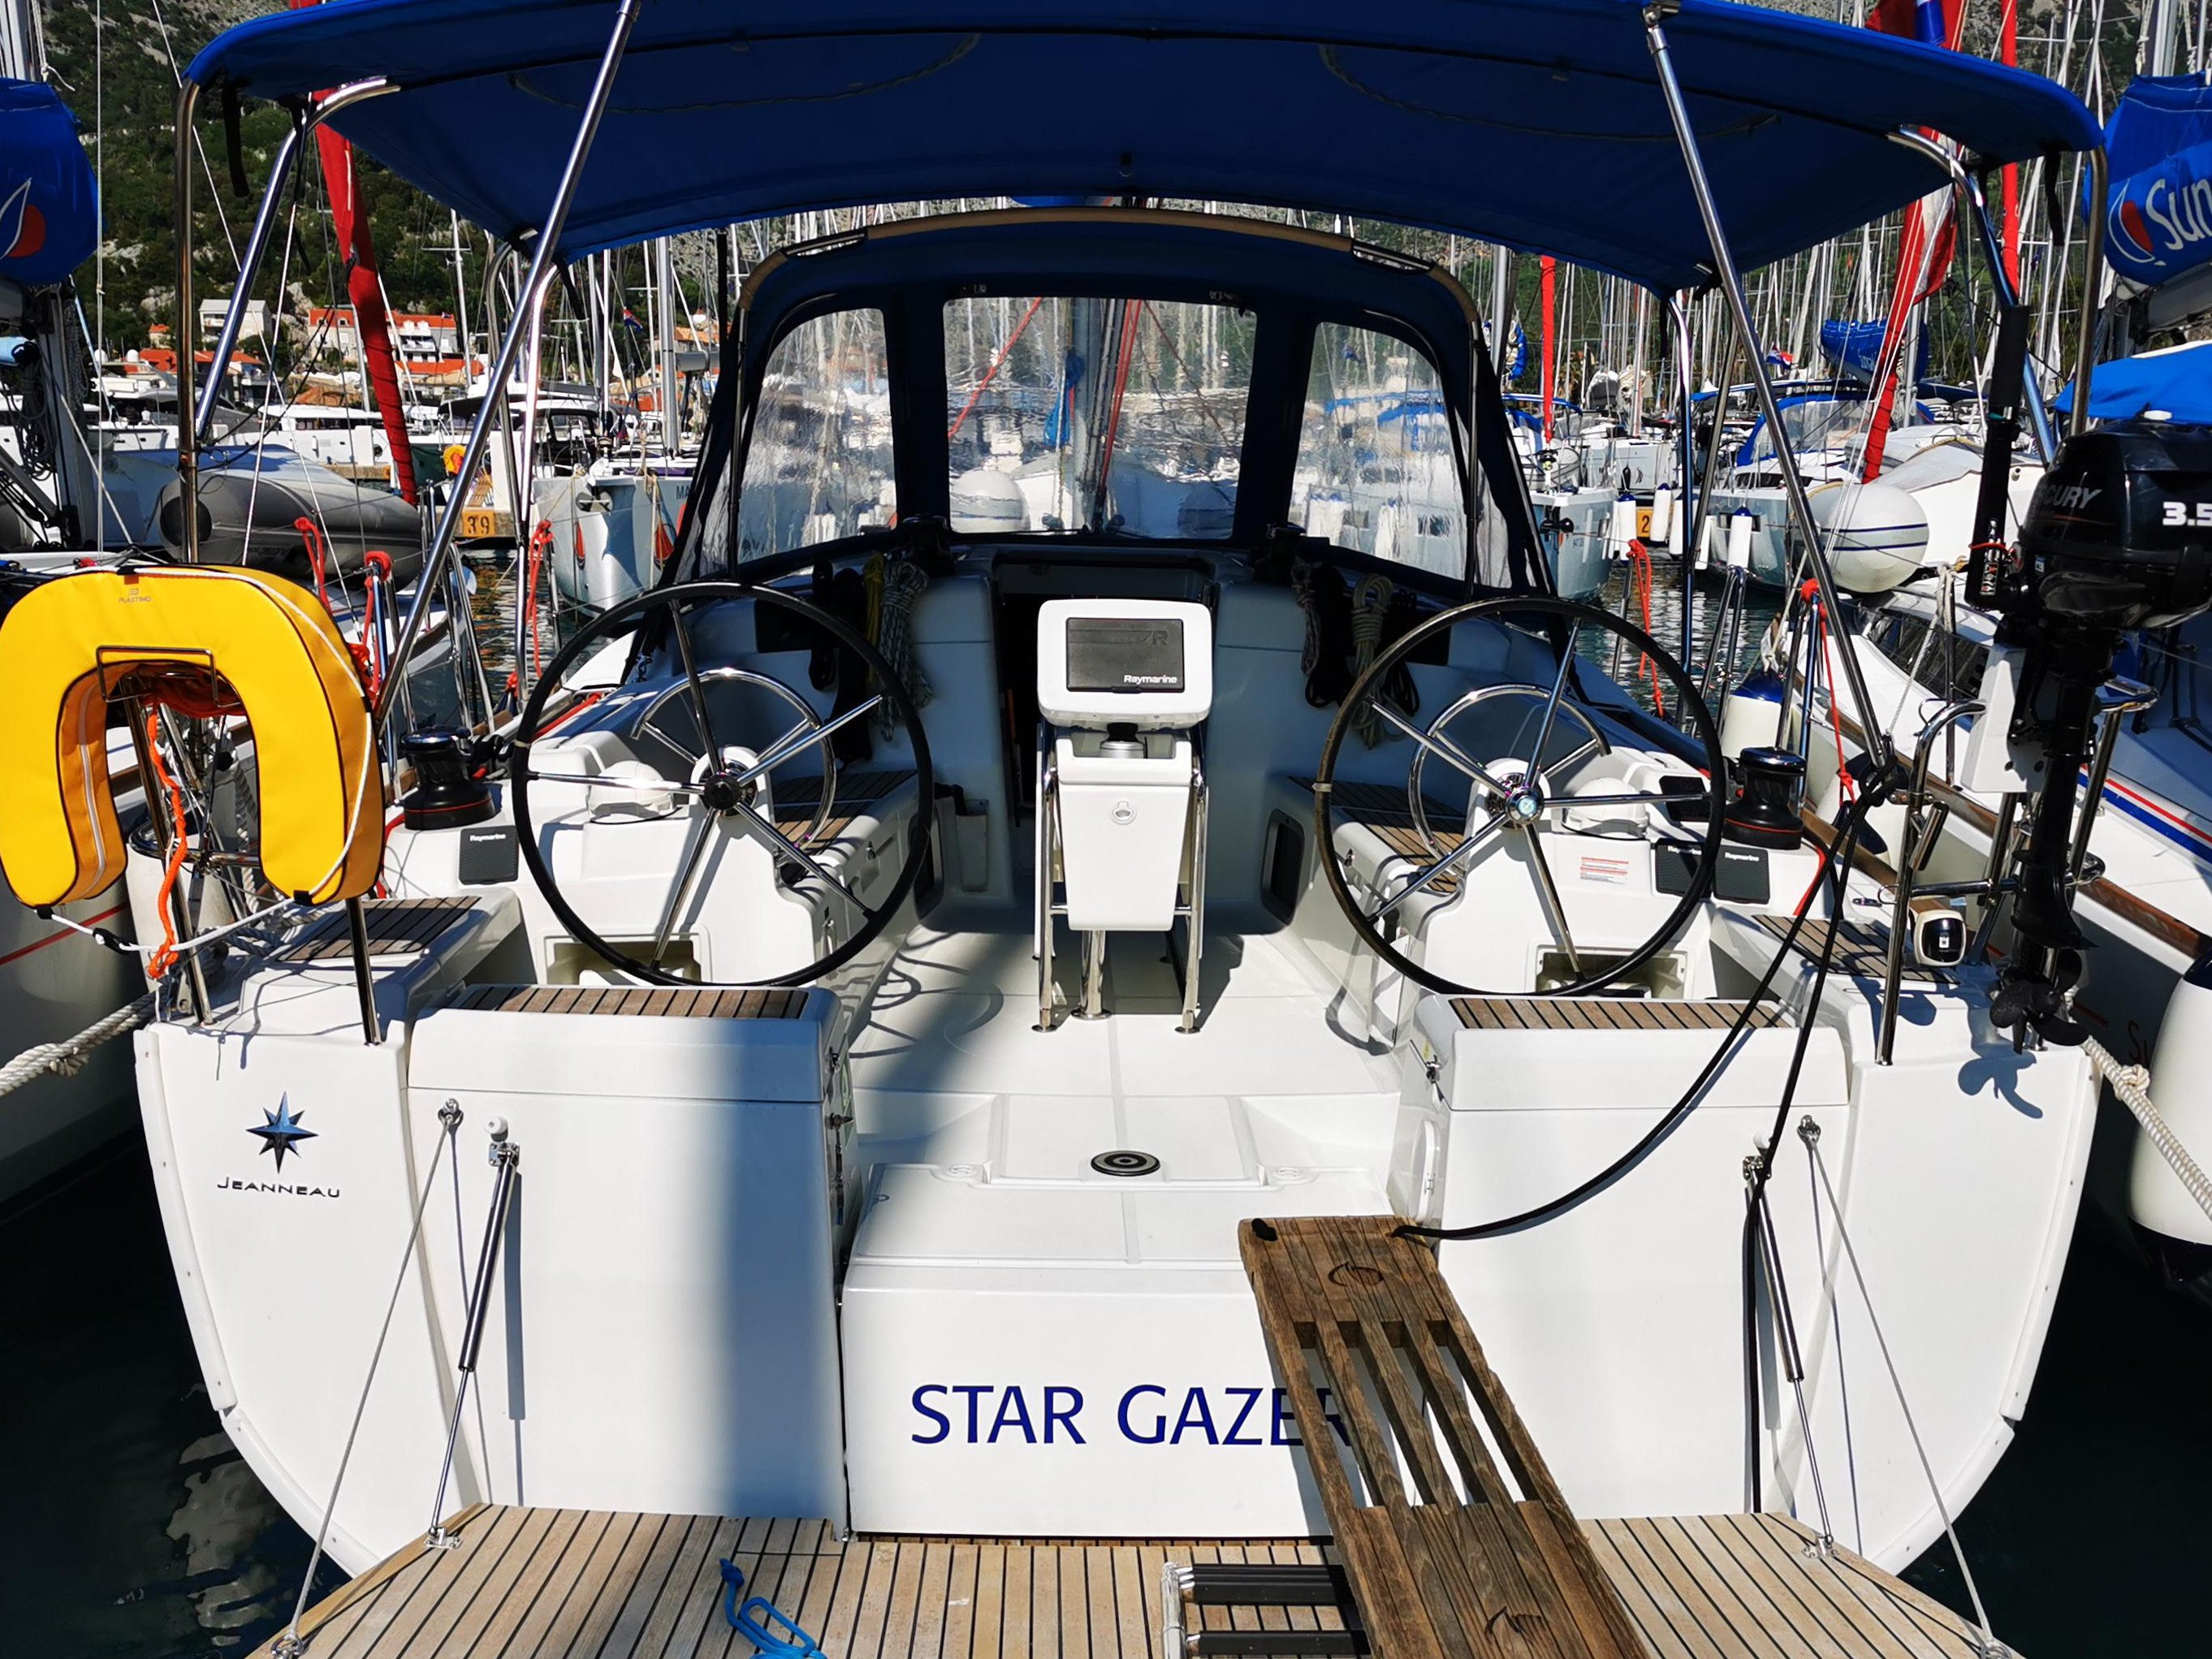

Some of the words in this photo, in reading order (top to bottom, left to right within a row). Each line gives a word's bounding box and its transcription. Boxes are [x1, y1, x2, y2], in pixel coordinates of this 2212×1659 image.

[2162, 501, 2212, 526] 3.5
[467, 516, 490, 535] 39
[119, 596, 152, 604] PLASTIMO
[1123, 674, 1177, 685] Raymarine
[469, 833, 506, 842] Raymarine
[1725, 852, 1760, 862] Raymarine
[217, 1177, 340, 1198] JEANNEAU
[911, 1385, 1087, 1445] STAR
